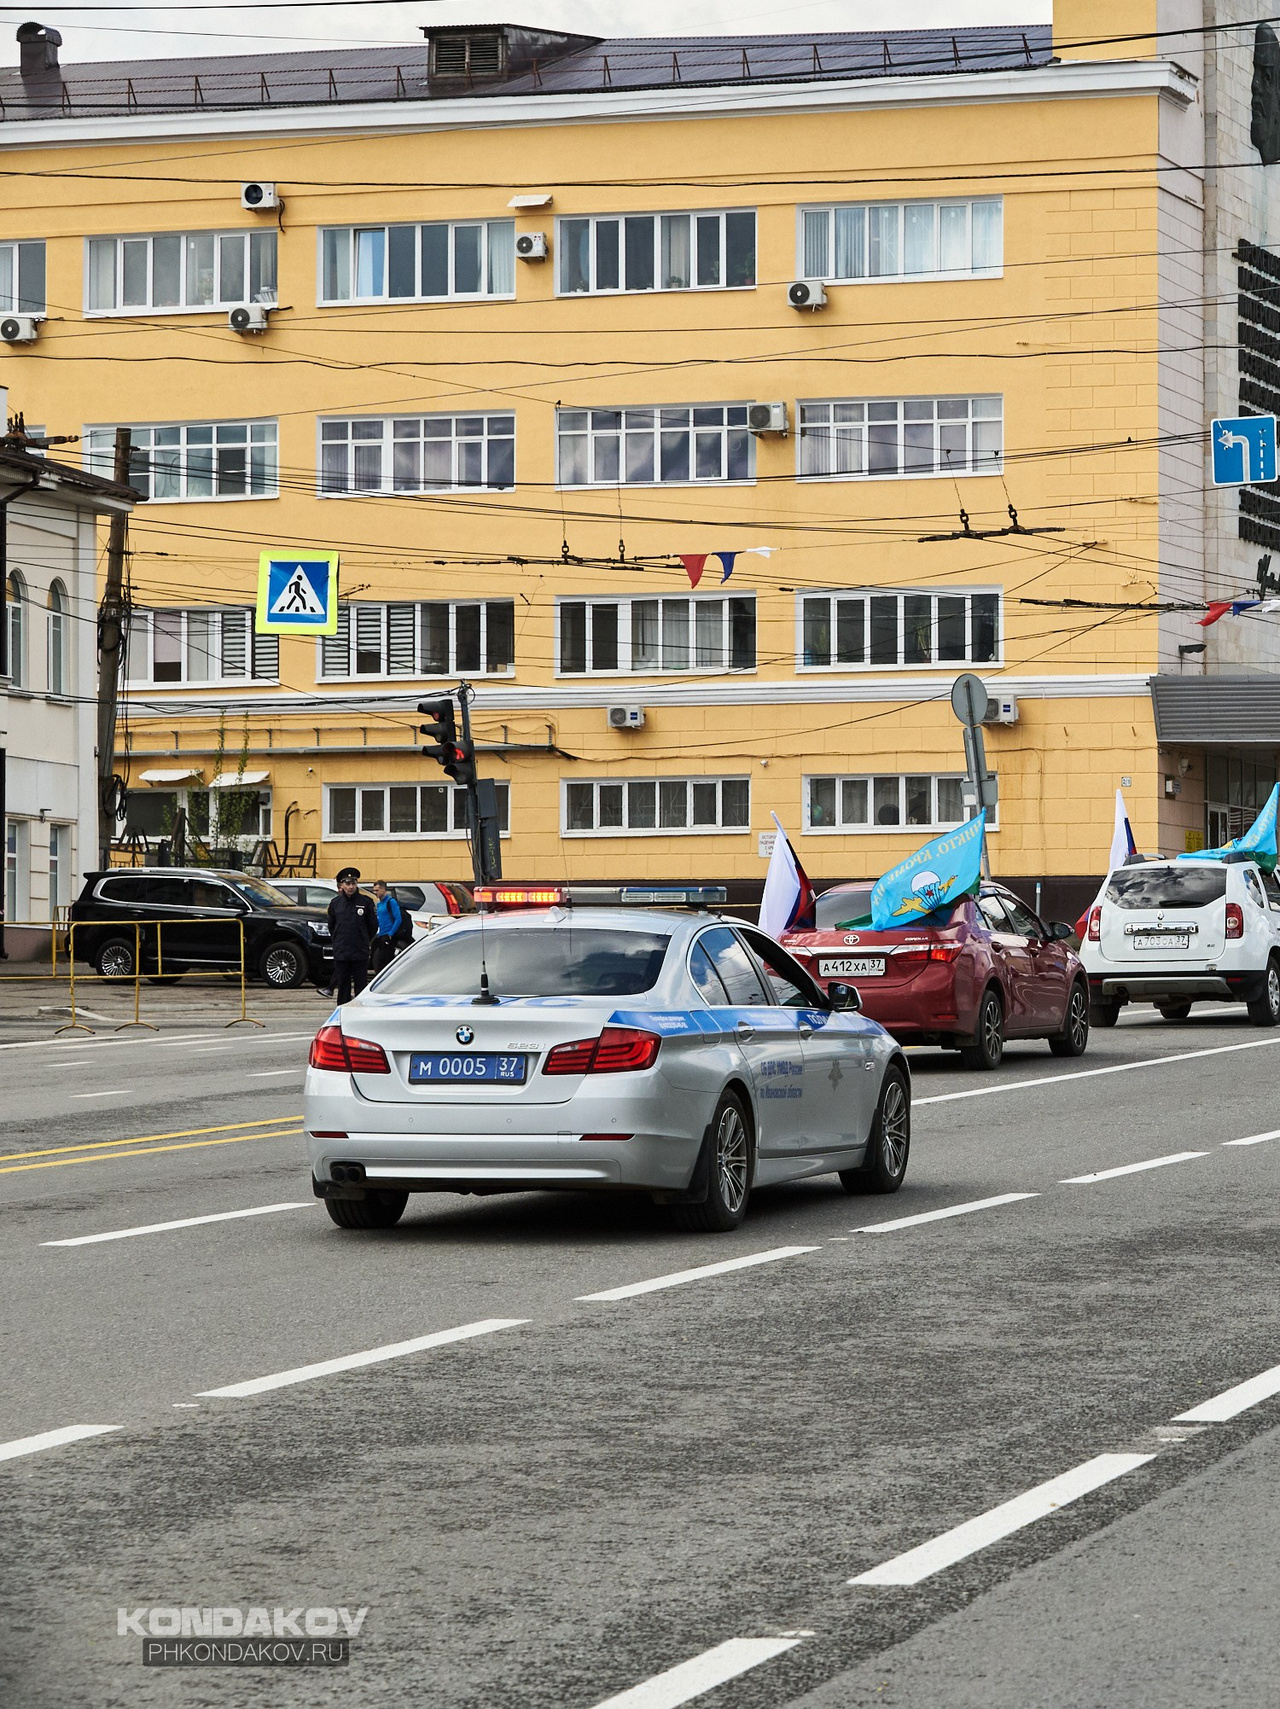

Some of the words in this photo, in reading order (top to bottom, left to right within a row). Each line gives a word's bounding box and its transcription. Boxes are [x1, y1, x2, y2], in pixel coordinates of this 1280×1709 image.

[870, 959, 882, 968] 37
[419, 1061, 432, 1076] М
[439, 1057, 487, 1076] 0005
[499, 1057, 518, 1072] 37
